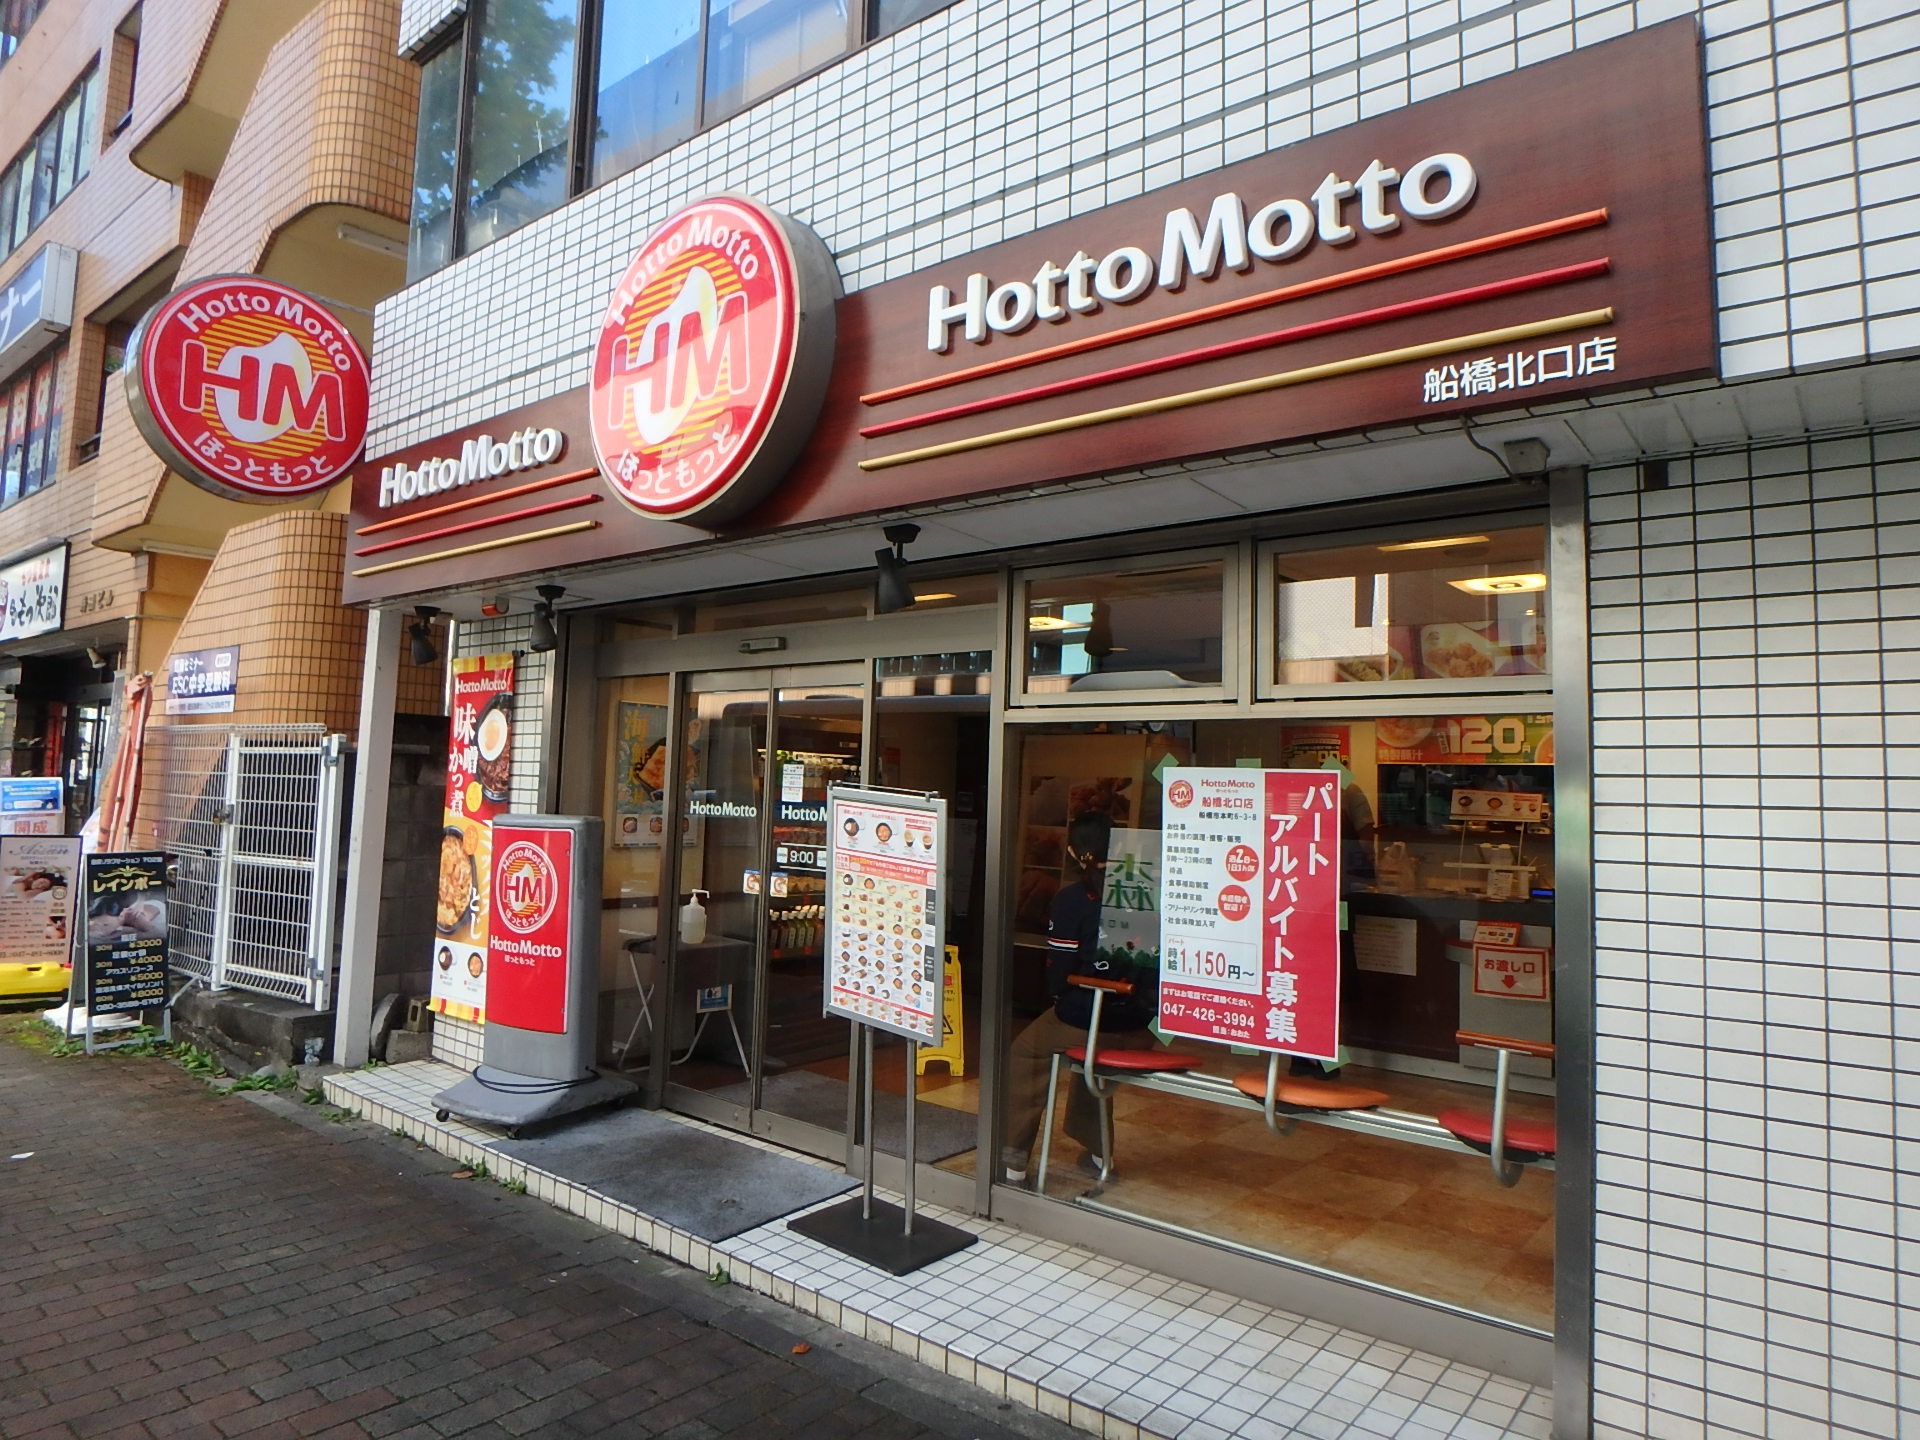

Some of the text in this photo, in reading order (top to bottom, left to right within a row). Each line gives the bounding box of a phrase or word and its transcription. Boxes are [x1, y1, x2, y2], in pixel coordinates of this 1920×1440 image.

[1423, 336, 1617, 403] 船橋北口店
[193, 431, 334, 485] ほっともっと
[617, 424, 737, 494] ほっともっと
[1201, 797, 1254, 809] 船橋北口店
[1302, 782, 1334, 876] パート
[789, 850, 814, 864] 9:00
[470, 887, 482, 940] とじ
[1265, 813, 1298, 1044] アルバイト募集
[1484, 958, 1535, 974] お渡し口
[1162, 1002, 1256, 1029] 047-426-3994
